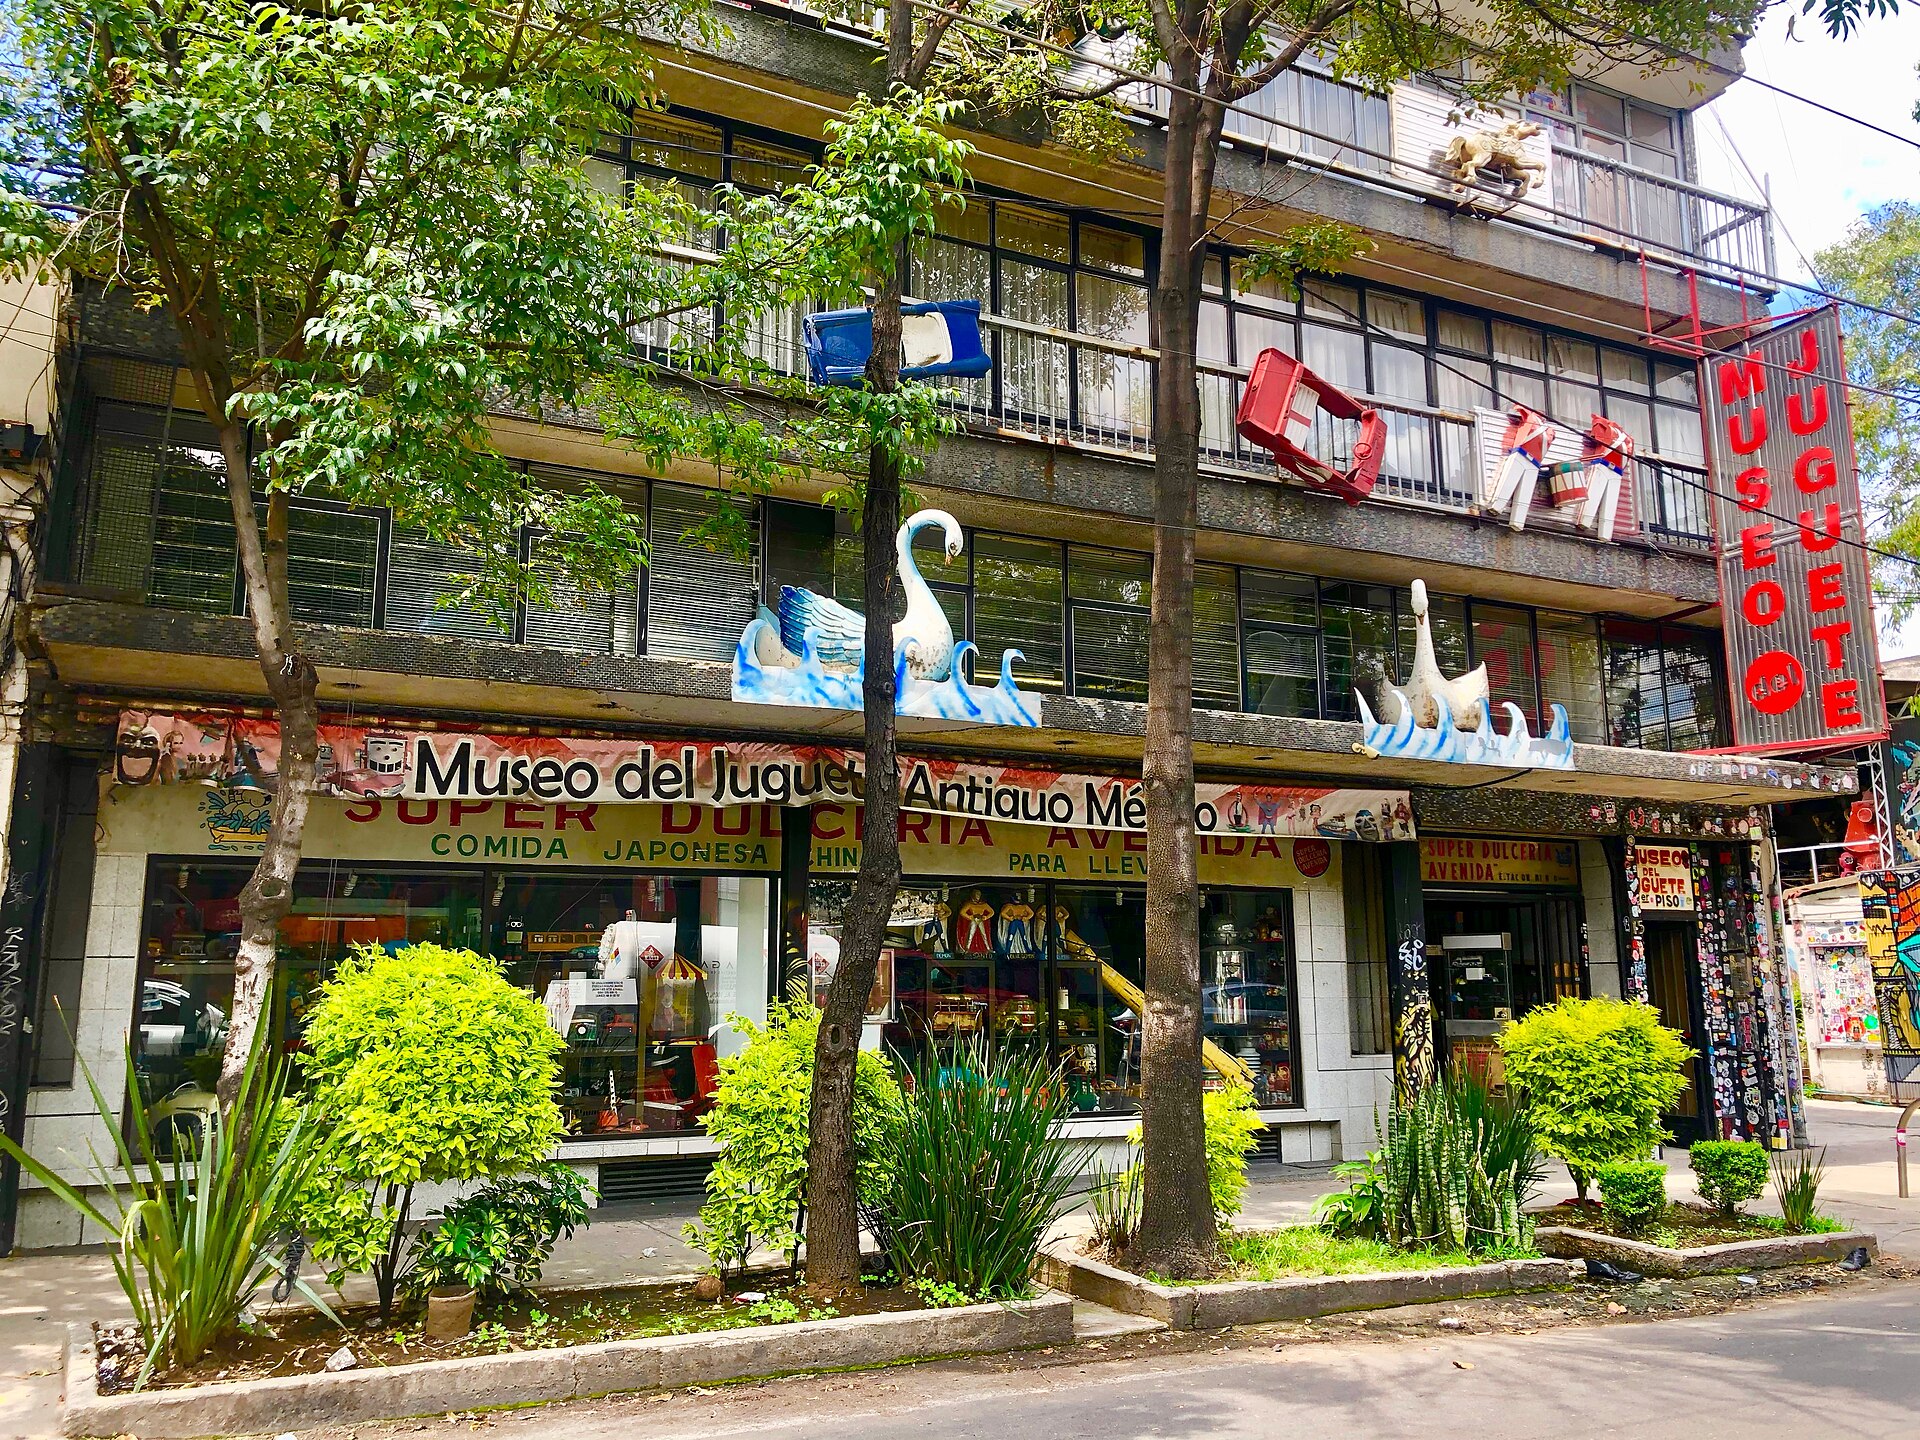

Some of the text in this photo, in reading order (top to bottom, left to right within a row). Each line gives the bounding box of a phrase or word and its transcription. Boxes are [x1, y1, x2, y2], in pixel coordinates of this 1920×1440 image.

[1718, 350, 1786, 627] MUSEO
[1786, 329, 1862, 729] JUGUETE
[1750, 662, 1801, 701] del
[414, 739, 599, 799] Museo
[614, 749, 696, 800] del
[710, 749, 865, 803] Juguet
[904, 764, 1074, 824] Antiguo
[344, 800, 1282, 859] SUPER DULCRIA AVEIDA
[431, 833, 569, 860] COMIDA
[603, 840, 768, 864] JAPONESA
[1009, 853, 1067, 873] PARA
[1642, 867, 1660, 877] DEL
[1655, 894, 1680, 908] PISO
